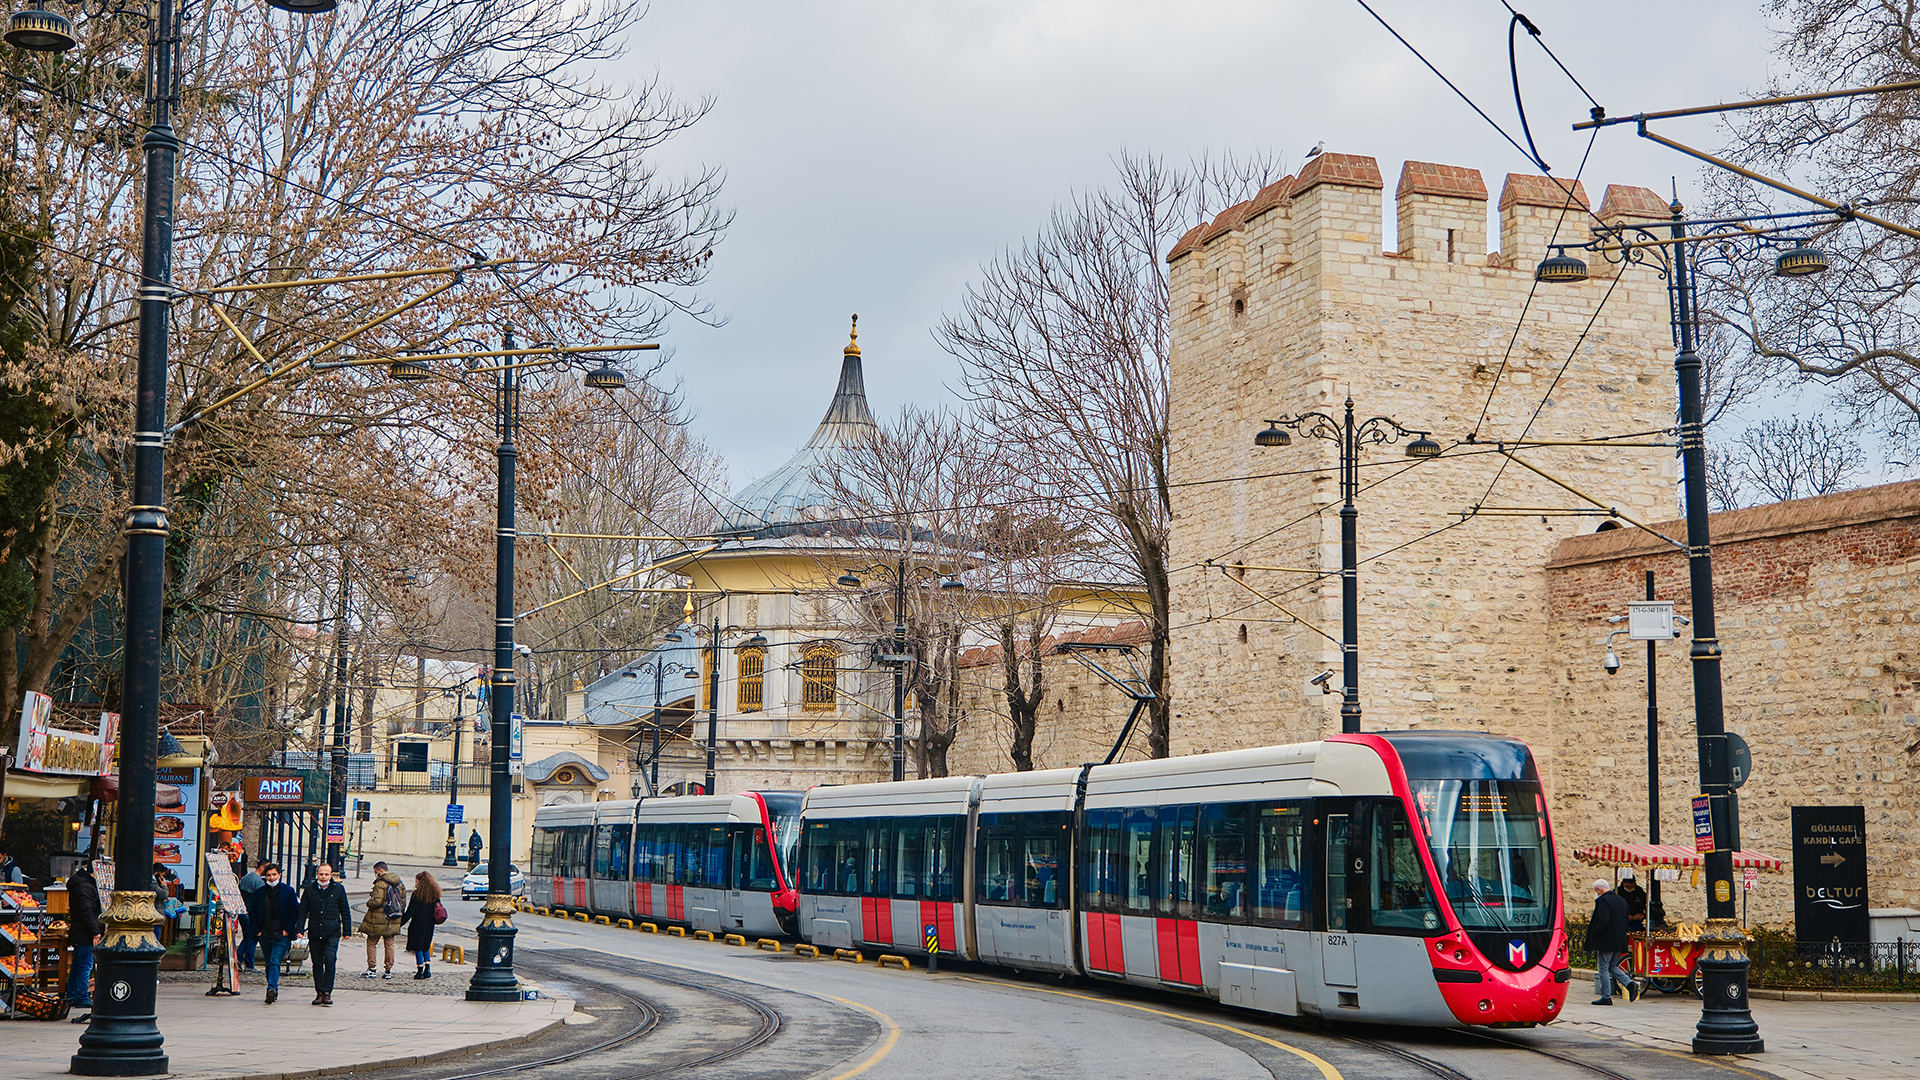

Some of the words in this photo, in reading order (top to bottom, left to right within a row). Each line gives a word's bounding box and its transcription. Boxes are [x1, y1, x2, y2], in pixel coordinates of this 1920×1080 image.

[259, 779, 301, 793] ANTİK
[1810, 823, 1853, 832] GÜLHANE
[1803, 836, 1837, 845] KANDİL
[1838, 837, 1862, 845] CAFE
[1513, 913, 1538, 924] 827A
[1328, 935, 1347, 946] 827A
